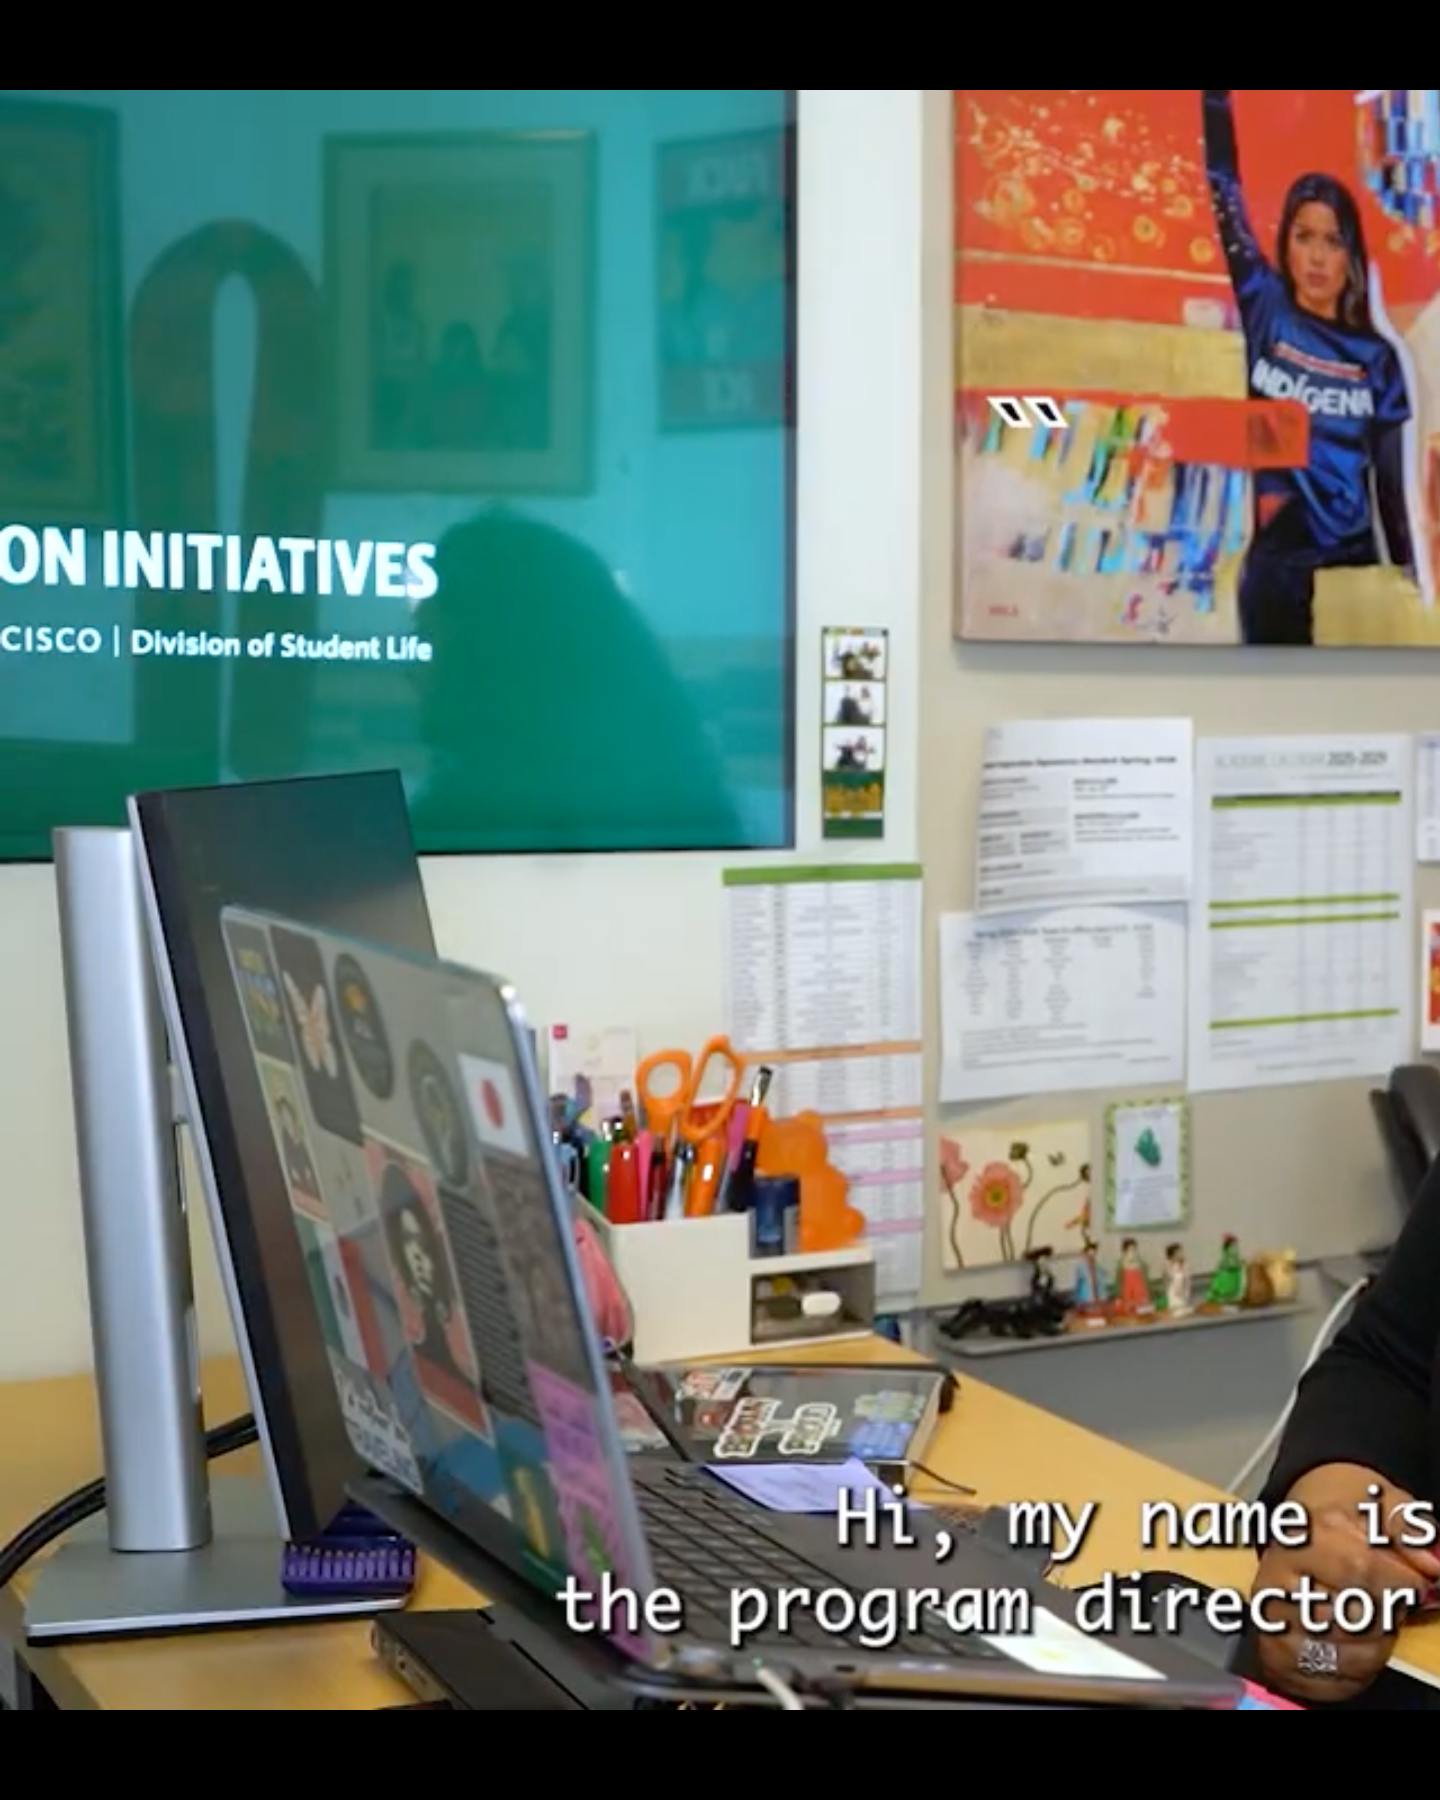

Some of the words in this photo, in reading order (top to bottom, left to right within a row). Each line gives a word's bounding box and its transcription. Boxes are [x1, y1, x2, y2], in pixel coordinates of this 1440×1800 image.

[0, 525, 86, 586] ON
[103, 530, 439, 601] INITIATIVES
[0, 626, 102, 653] CISCO
[131, 629, 241, 656] Division
[247, 632, 275, 658] of
[281, 633, 380, 660] Student
[386, 636, 433, 662] Life
